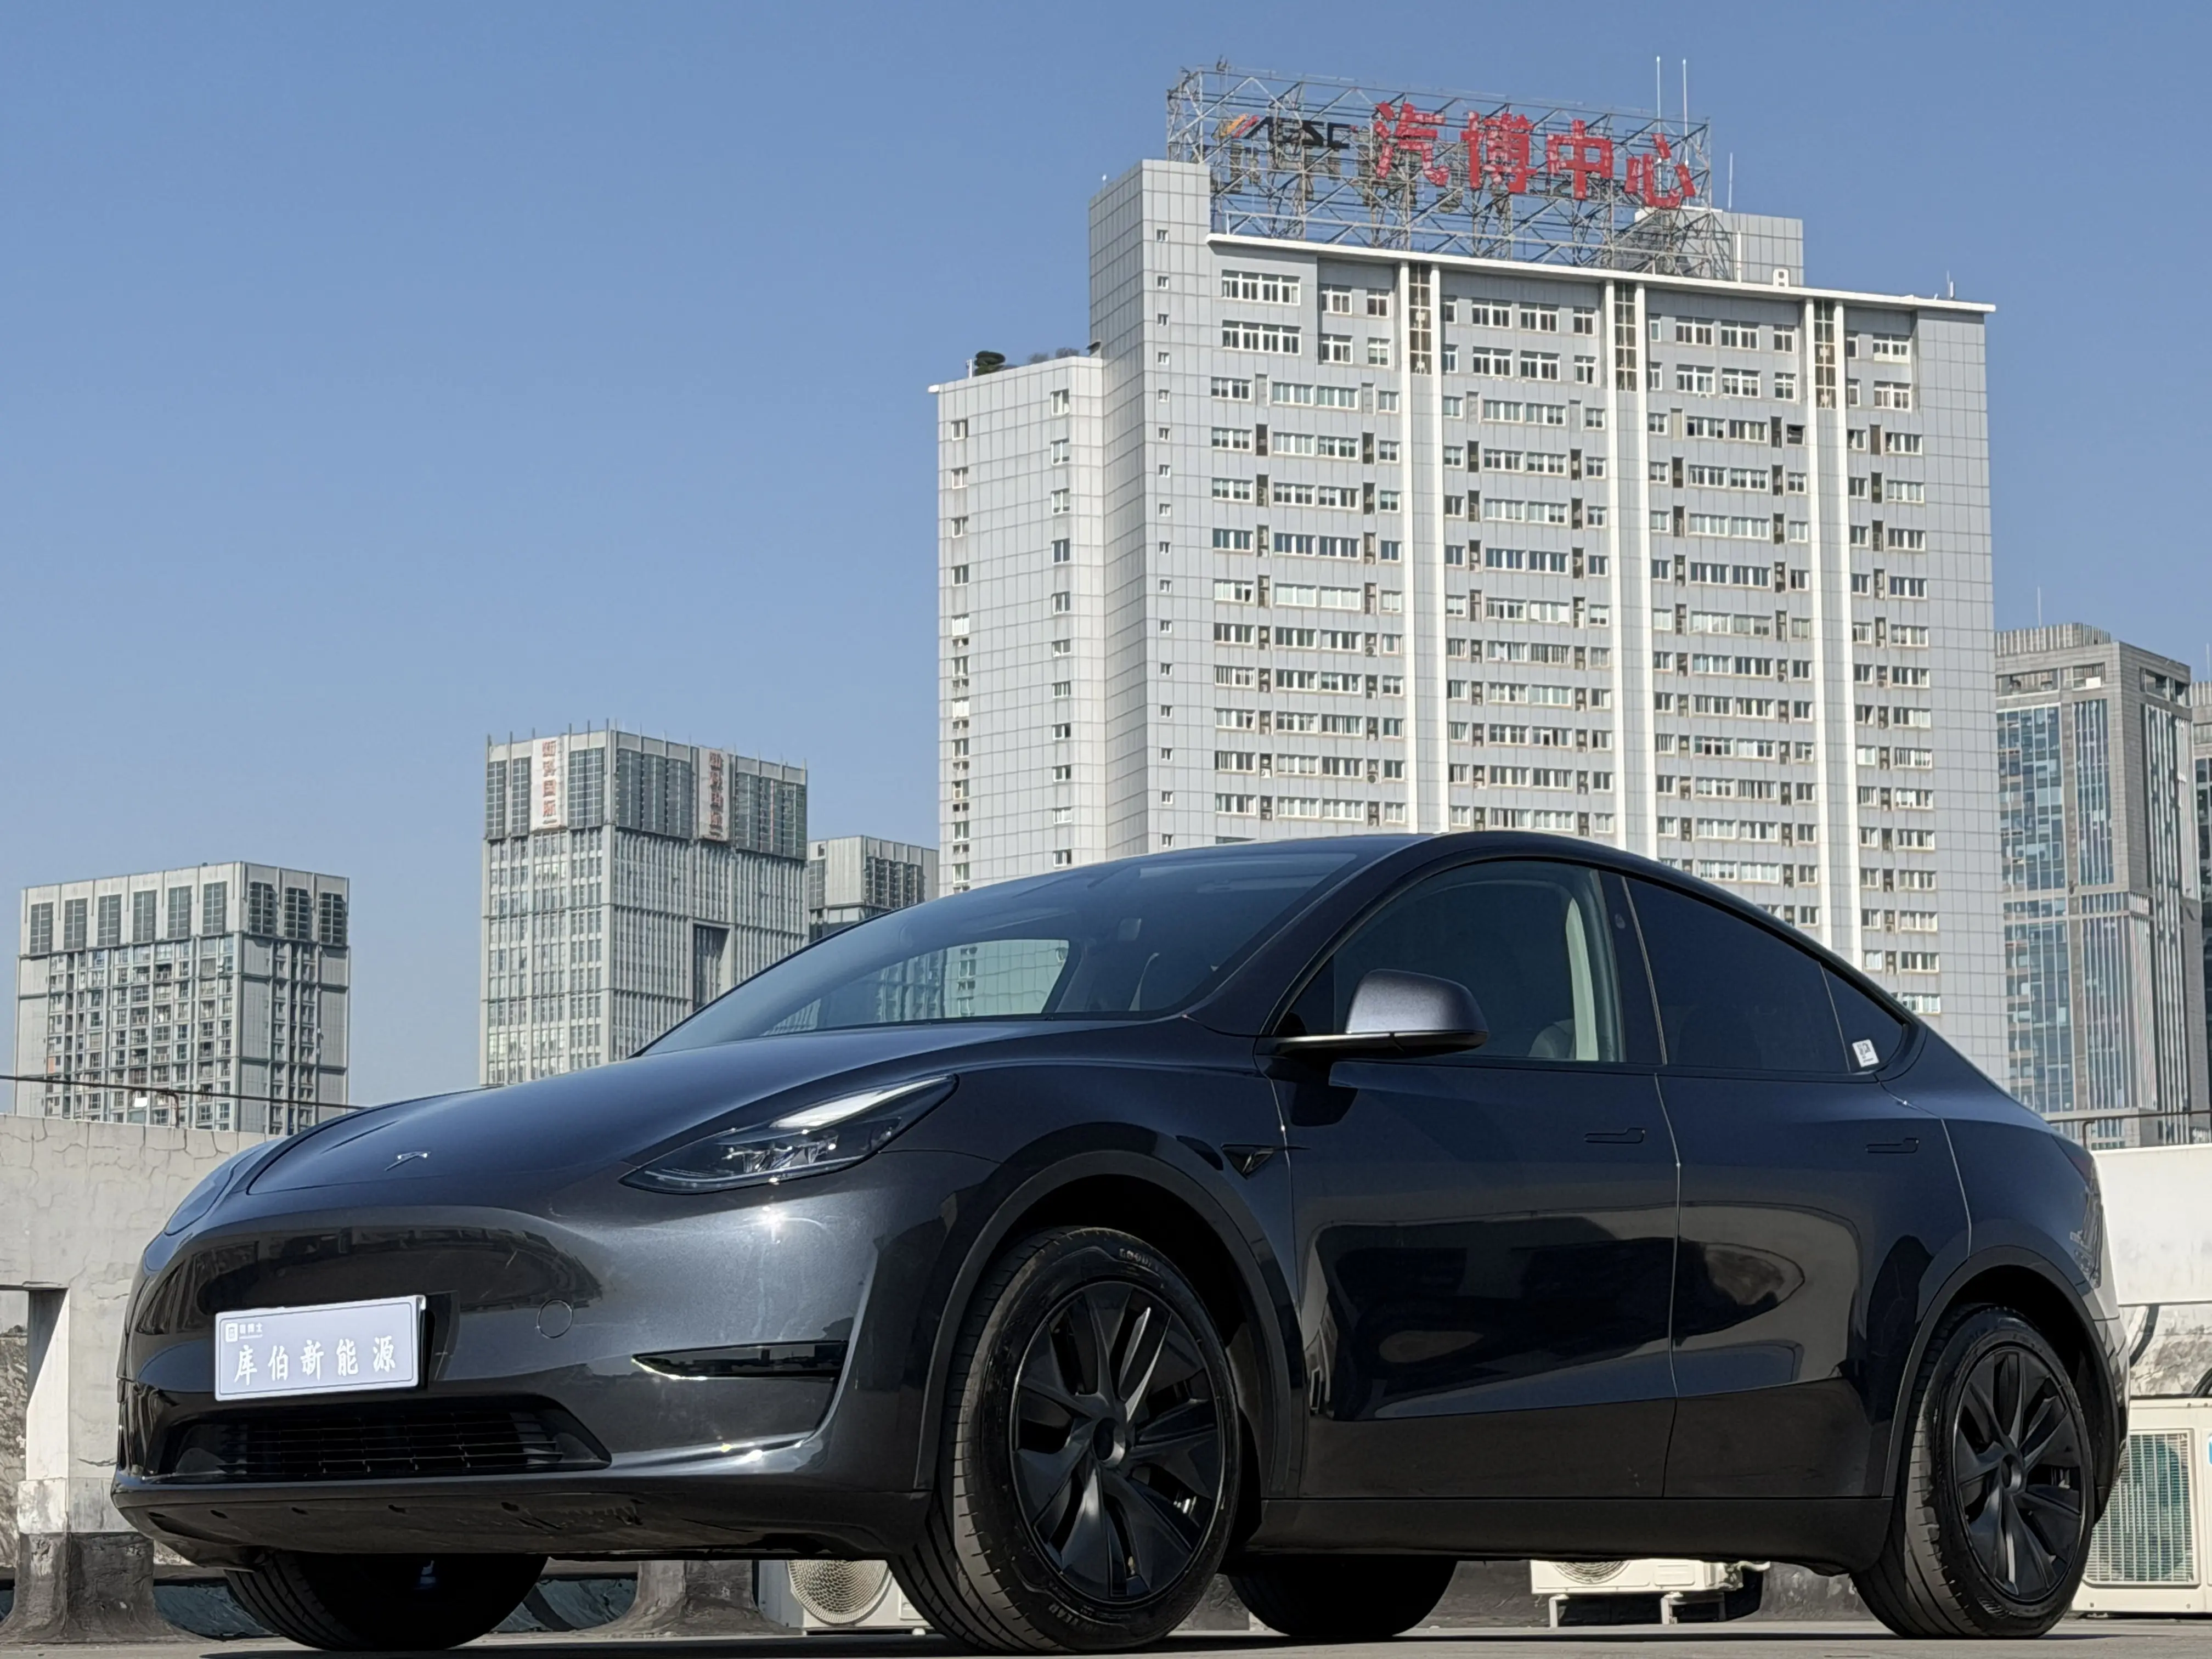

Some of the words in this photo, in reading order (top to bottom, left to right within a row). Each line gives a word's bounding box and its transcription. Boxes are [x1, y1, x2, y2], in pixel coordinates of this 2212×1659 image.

[1374, 102, 1695, 208] 汽博中心
[234, 1335, 396, 1385] 库伯新能源
